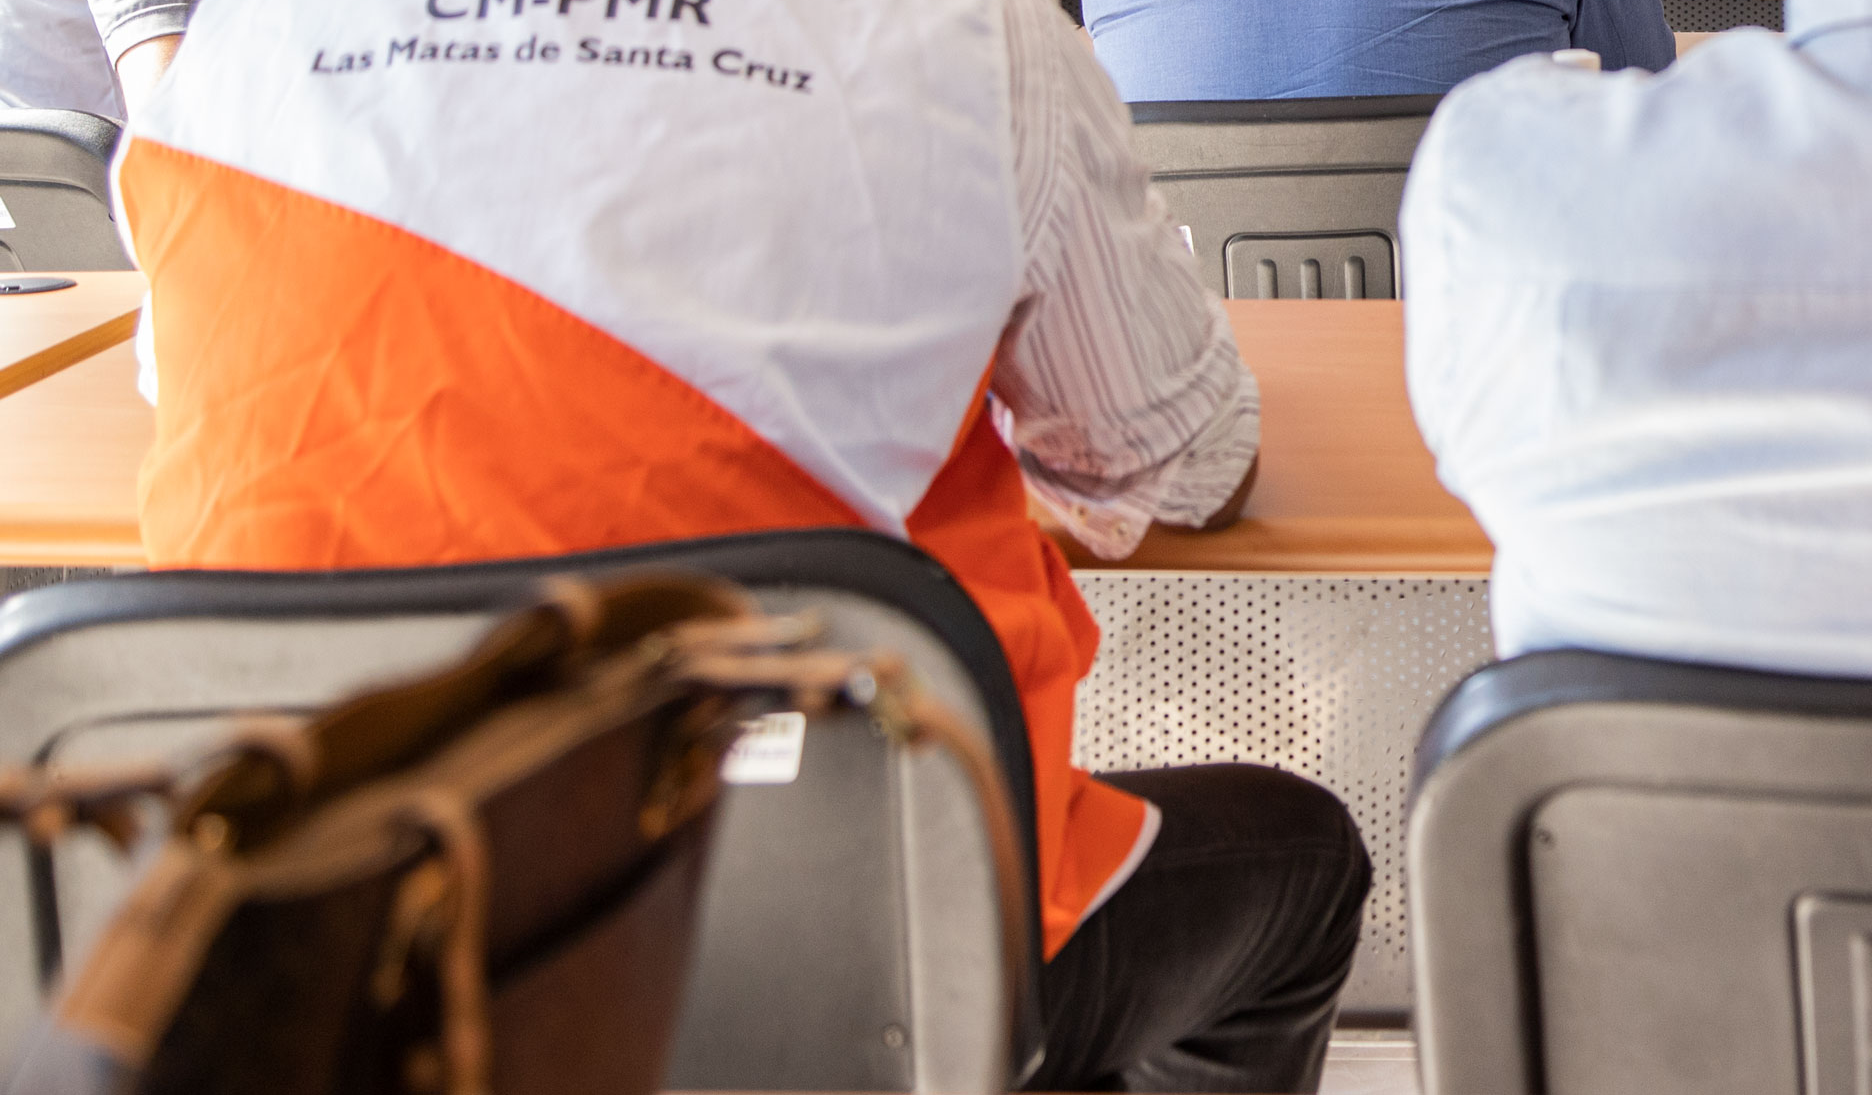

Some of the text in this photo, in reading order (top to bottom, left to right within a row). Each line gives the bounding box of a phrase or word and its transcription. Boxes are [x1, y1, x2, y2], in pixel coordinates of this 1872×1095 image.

[310, 34, 814, 94] Las Matas de Santa Cruz
